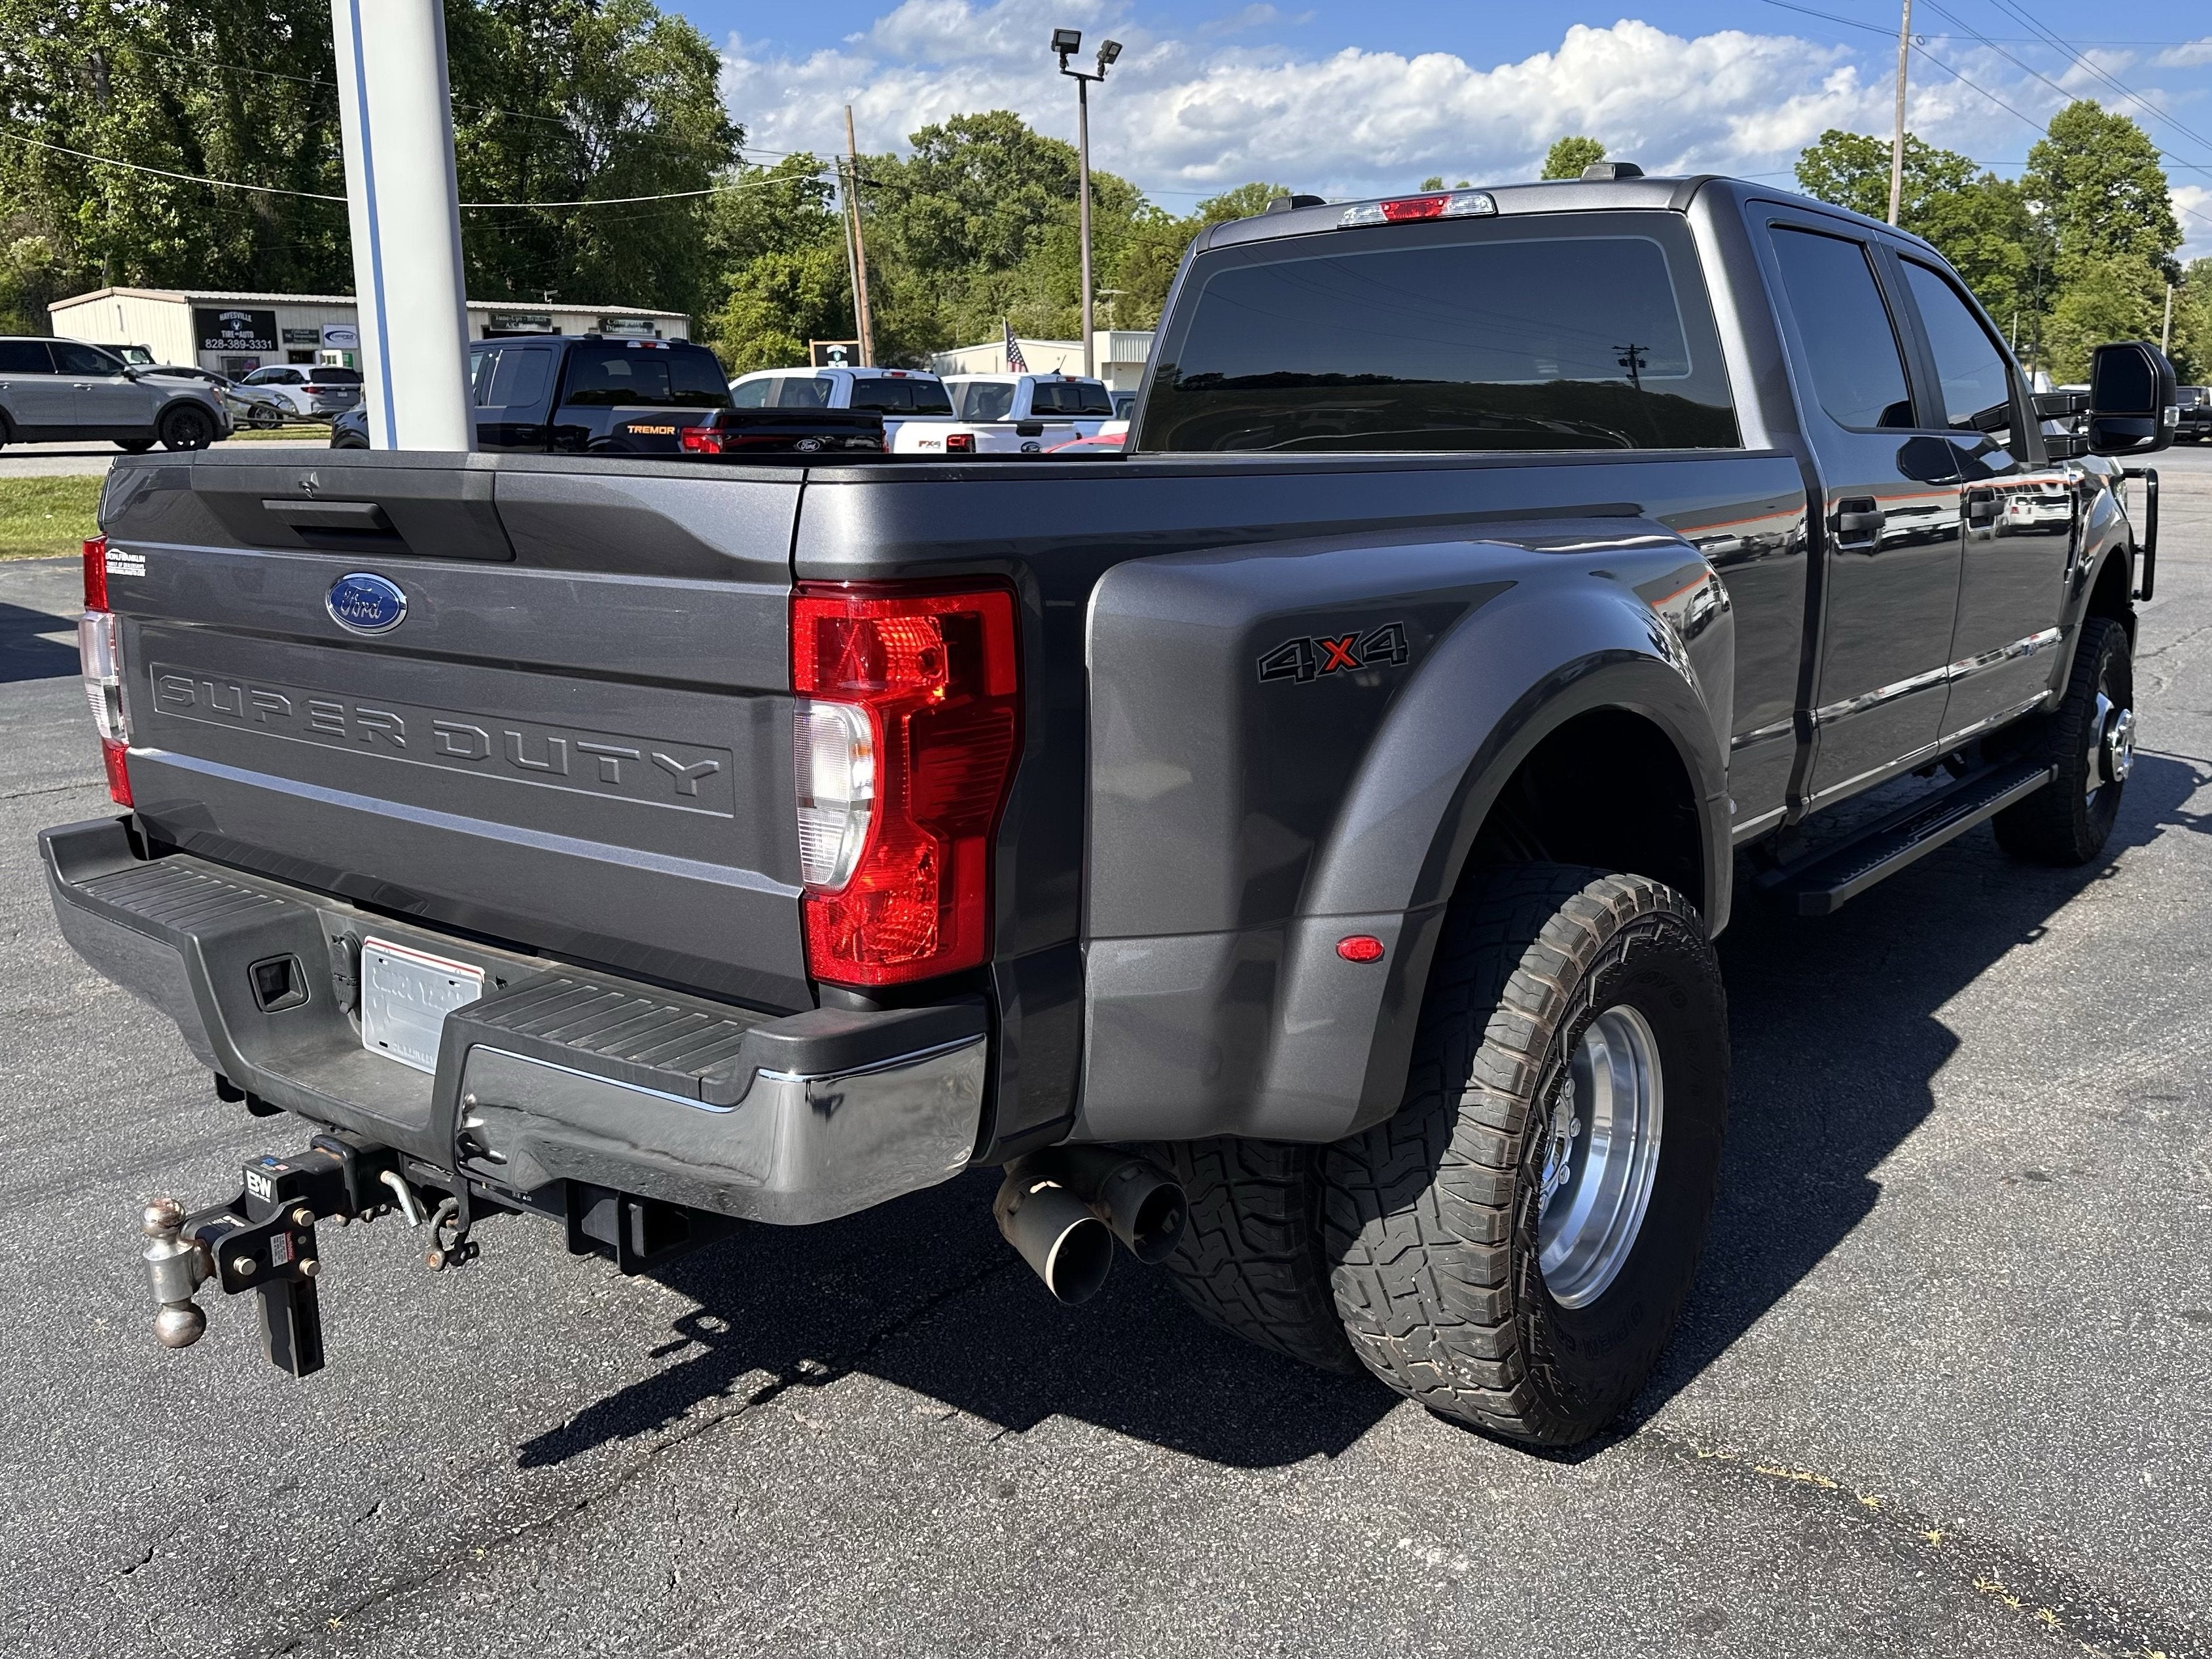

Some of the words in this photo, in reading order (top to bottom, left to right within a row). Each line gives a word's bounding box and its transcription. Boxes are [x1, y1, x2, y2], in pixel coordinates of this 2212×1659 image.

[219, 312, 252, 322] HAYESVILLE
[221, 330, 234, 338] TIRE
[606, 325, 647, 333] Diagnostics
[205, 338, 272, 349] 828-389-3331
[627, 425, 675, 435] TREMOR
[800, 440, 817, 450] Ford
[341, 584, 385, 621] Ford
[158, 674, 406, 749] SUPER
[432, 719, 721, 797] DUTY
